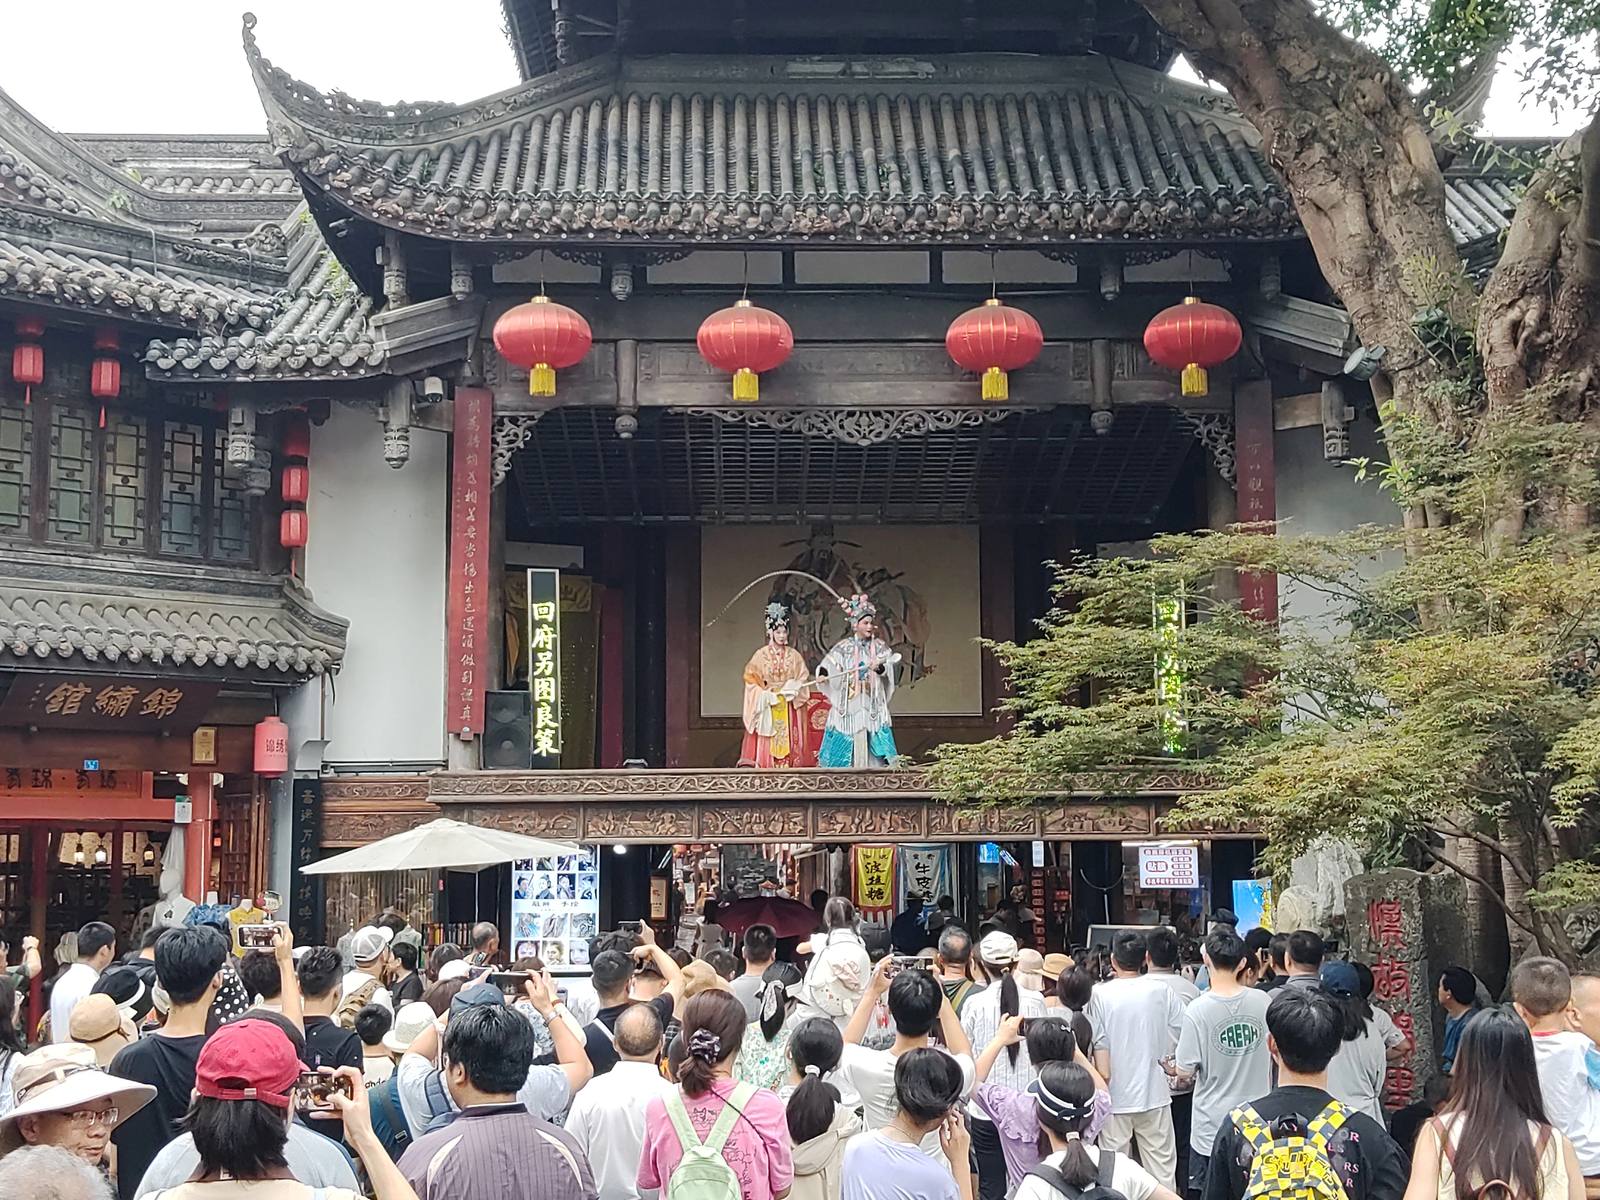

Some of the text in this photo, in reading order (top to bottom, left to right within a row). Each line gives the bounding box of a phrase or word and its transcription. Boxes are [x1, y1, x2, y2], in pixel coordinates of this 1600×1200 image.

[532, 601, 559, 757] 回府另图良策
